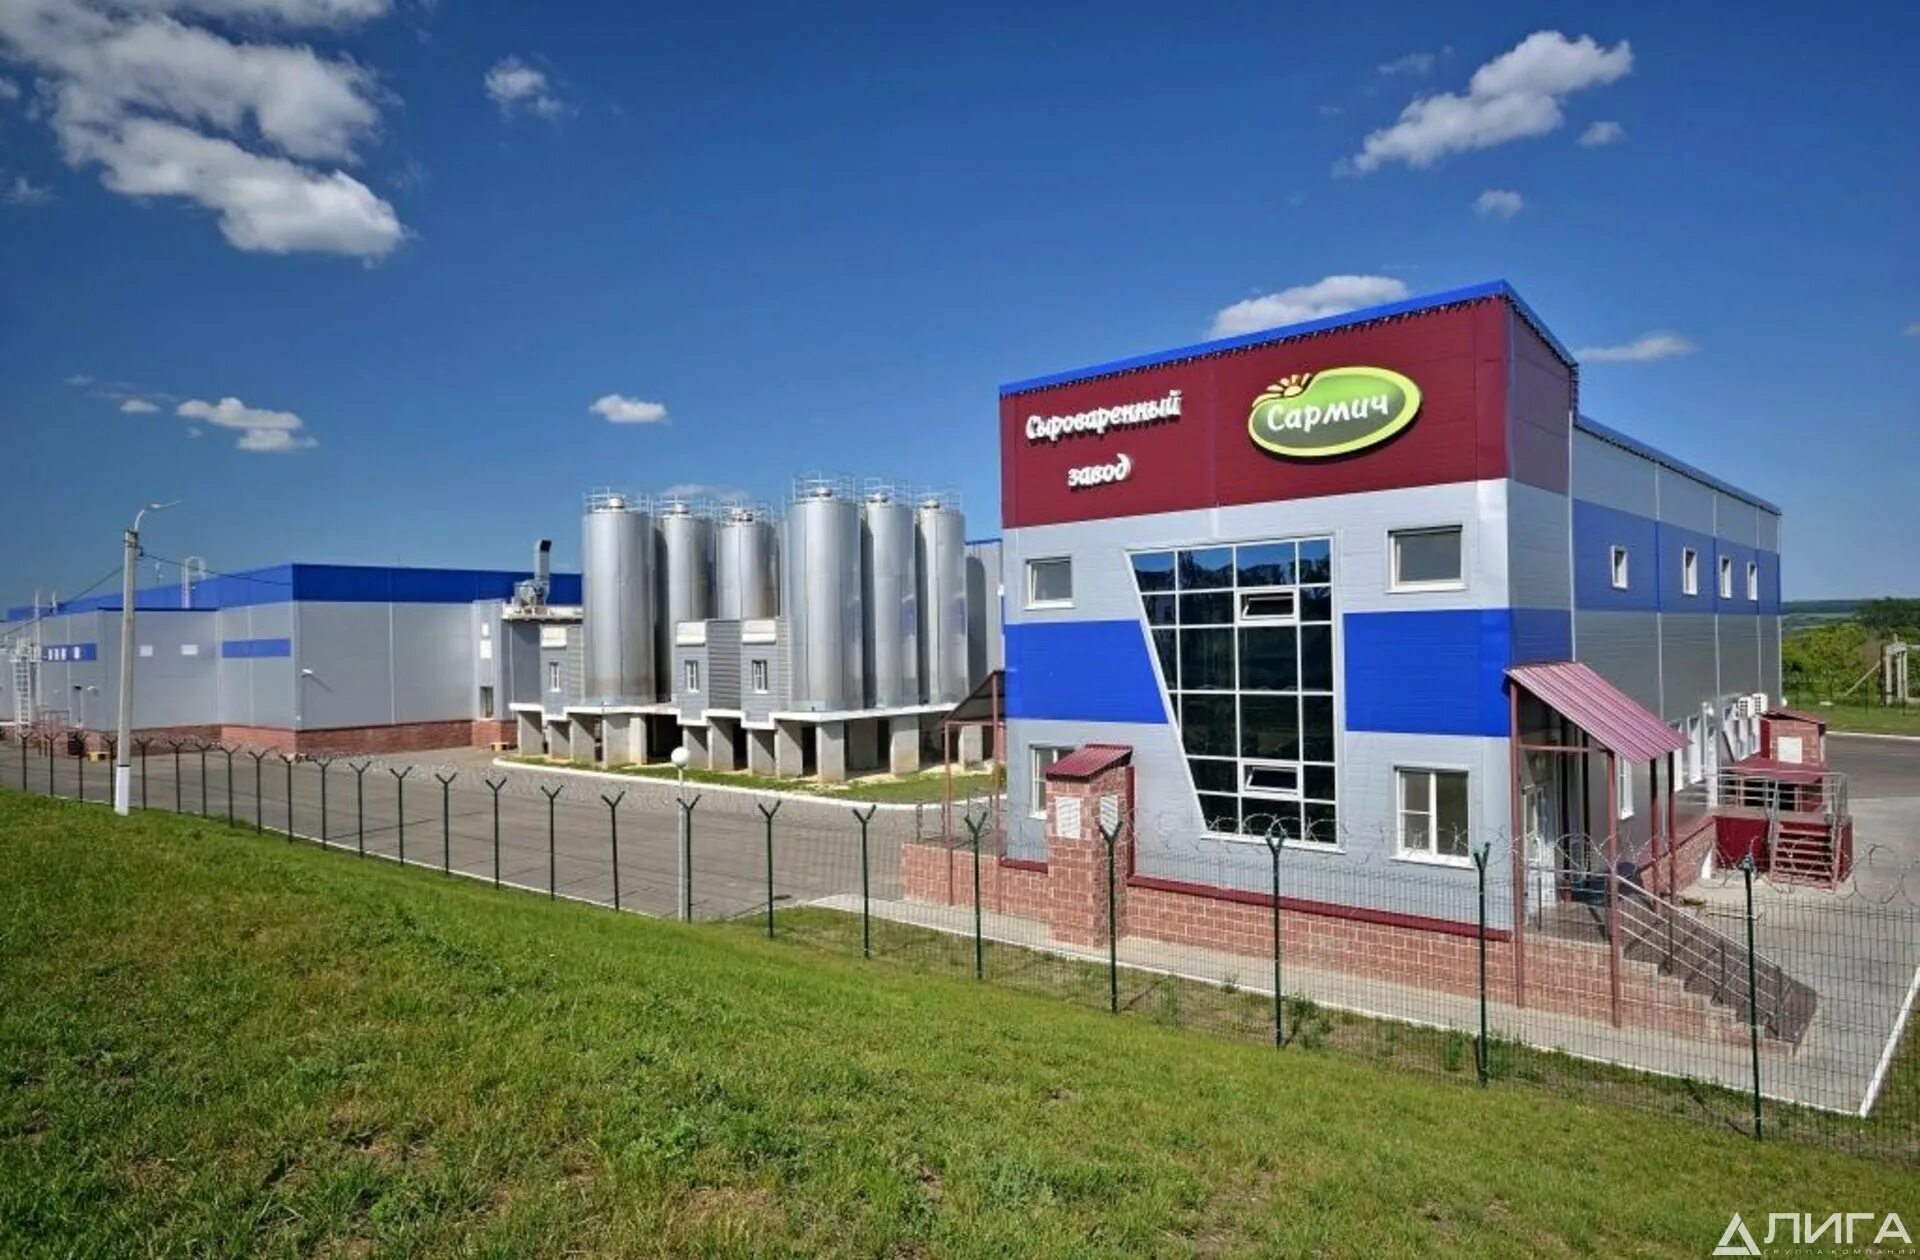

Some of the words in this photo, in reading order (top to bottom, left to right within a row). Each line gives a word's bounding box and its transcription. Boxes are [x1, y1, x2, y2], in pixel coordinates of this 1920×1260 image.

[1025, 389, 1182, 441] Сыроваренный
[1267, 390, 1389, 433] Сармич
[1067, 453, 1132, 487] завод
